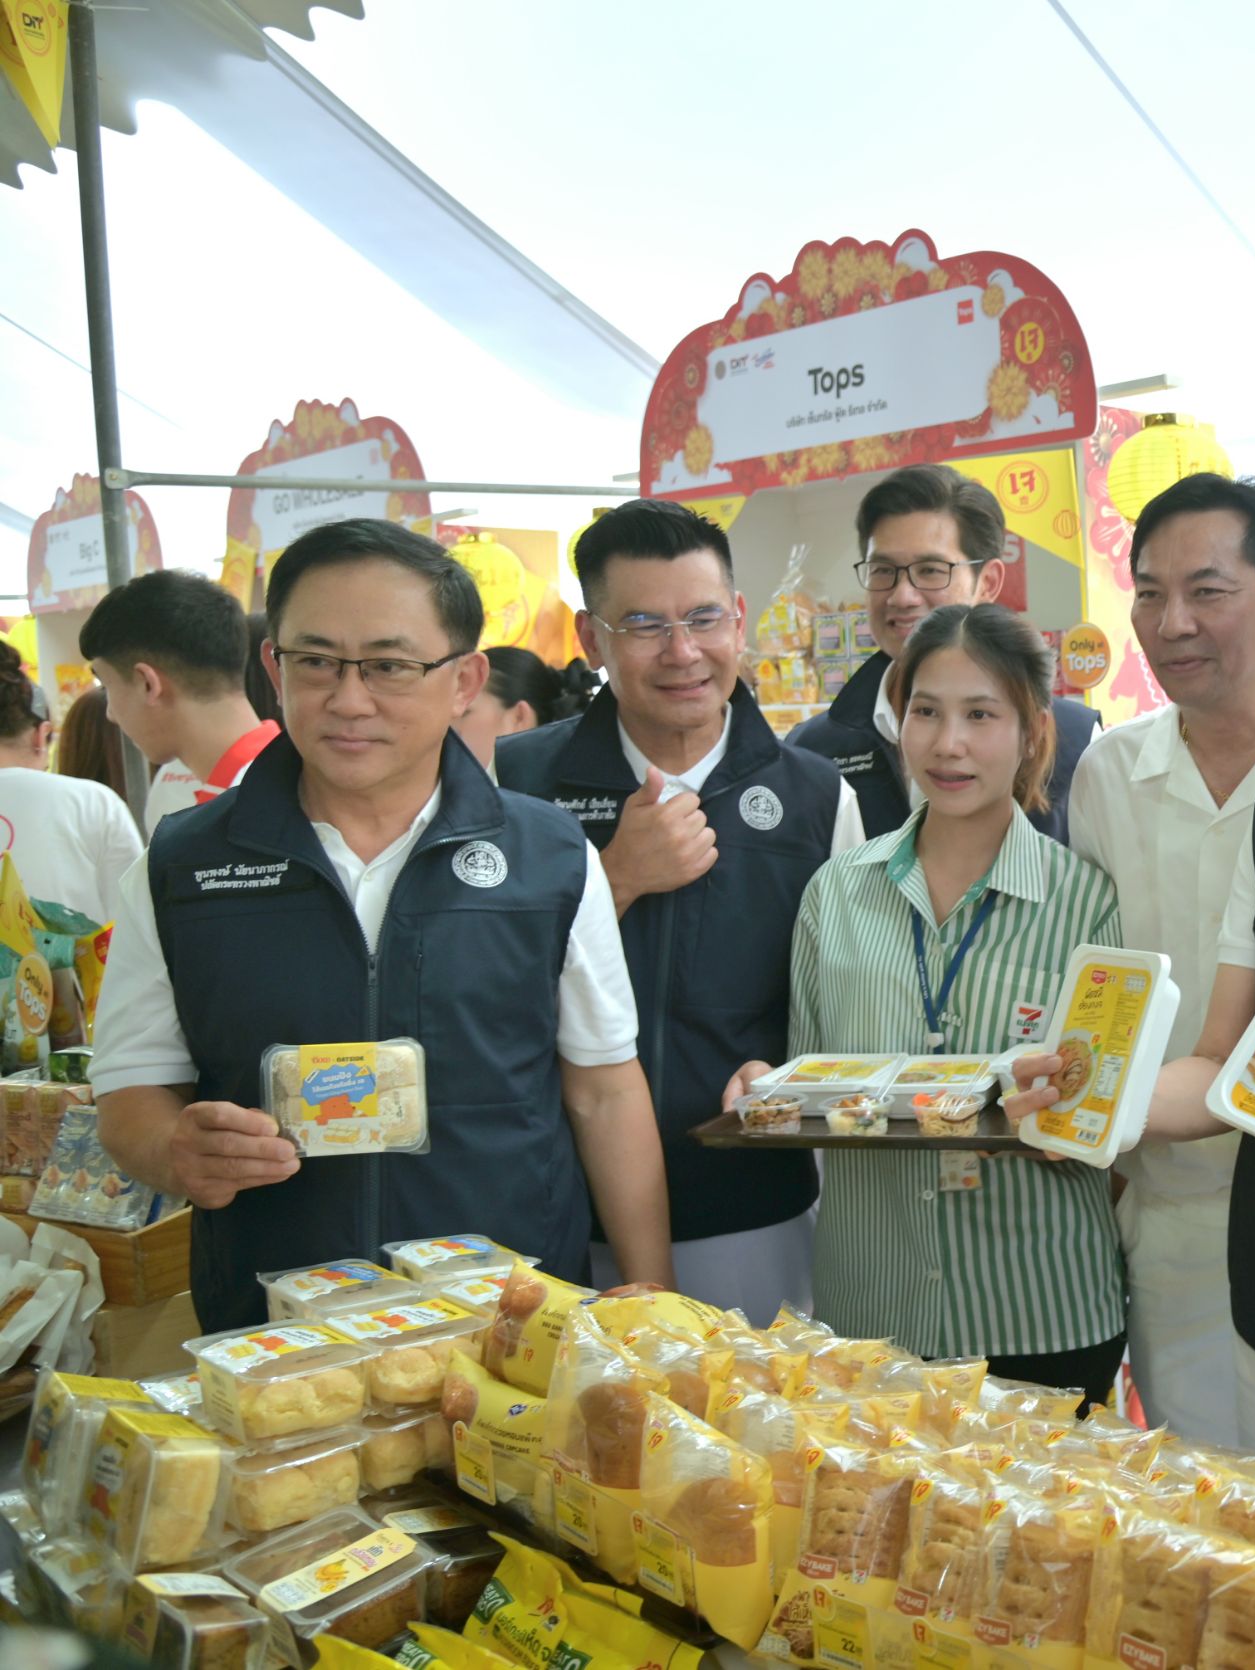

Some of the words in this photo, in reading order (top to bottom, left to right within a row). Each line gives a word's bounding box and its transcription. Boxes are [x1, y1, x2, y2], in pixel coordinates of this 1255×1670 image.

[808, 363, 865, 399] Tops
[79, 542, 92, 562] Big
[93, 540, 99, 556] C
[1069, 637, 1095, 655] Only
[1066, 652, 1107, 674] Tops
[18, 978, 47, 1022] Tops
